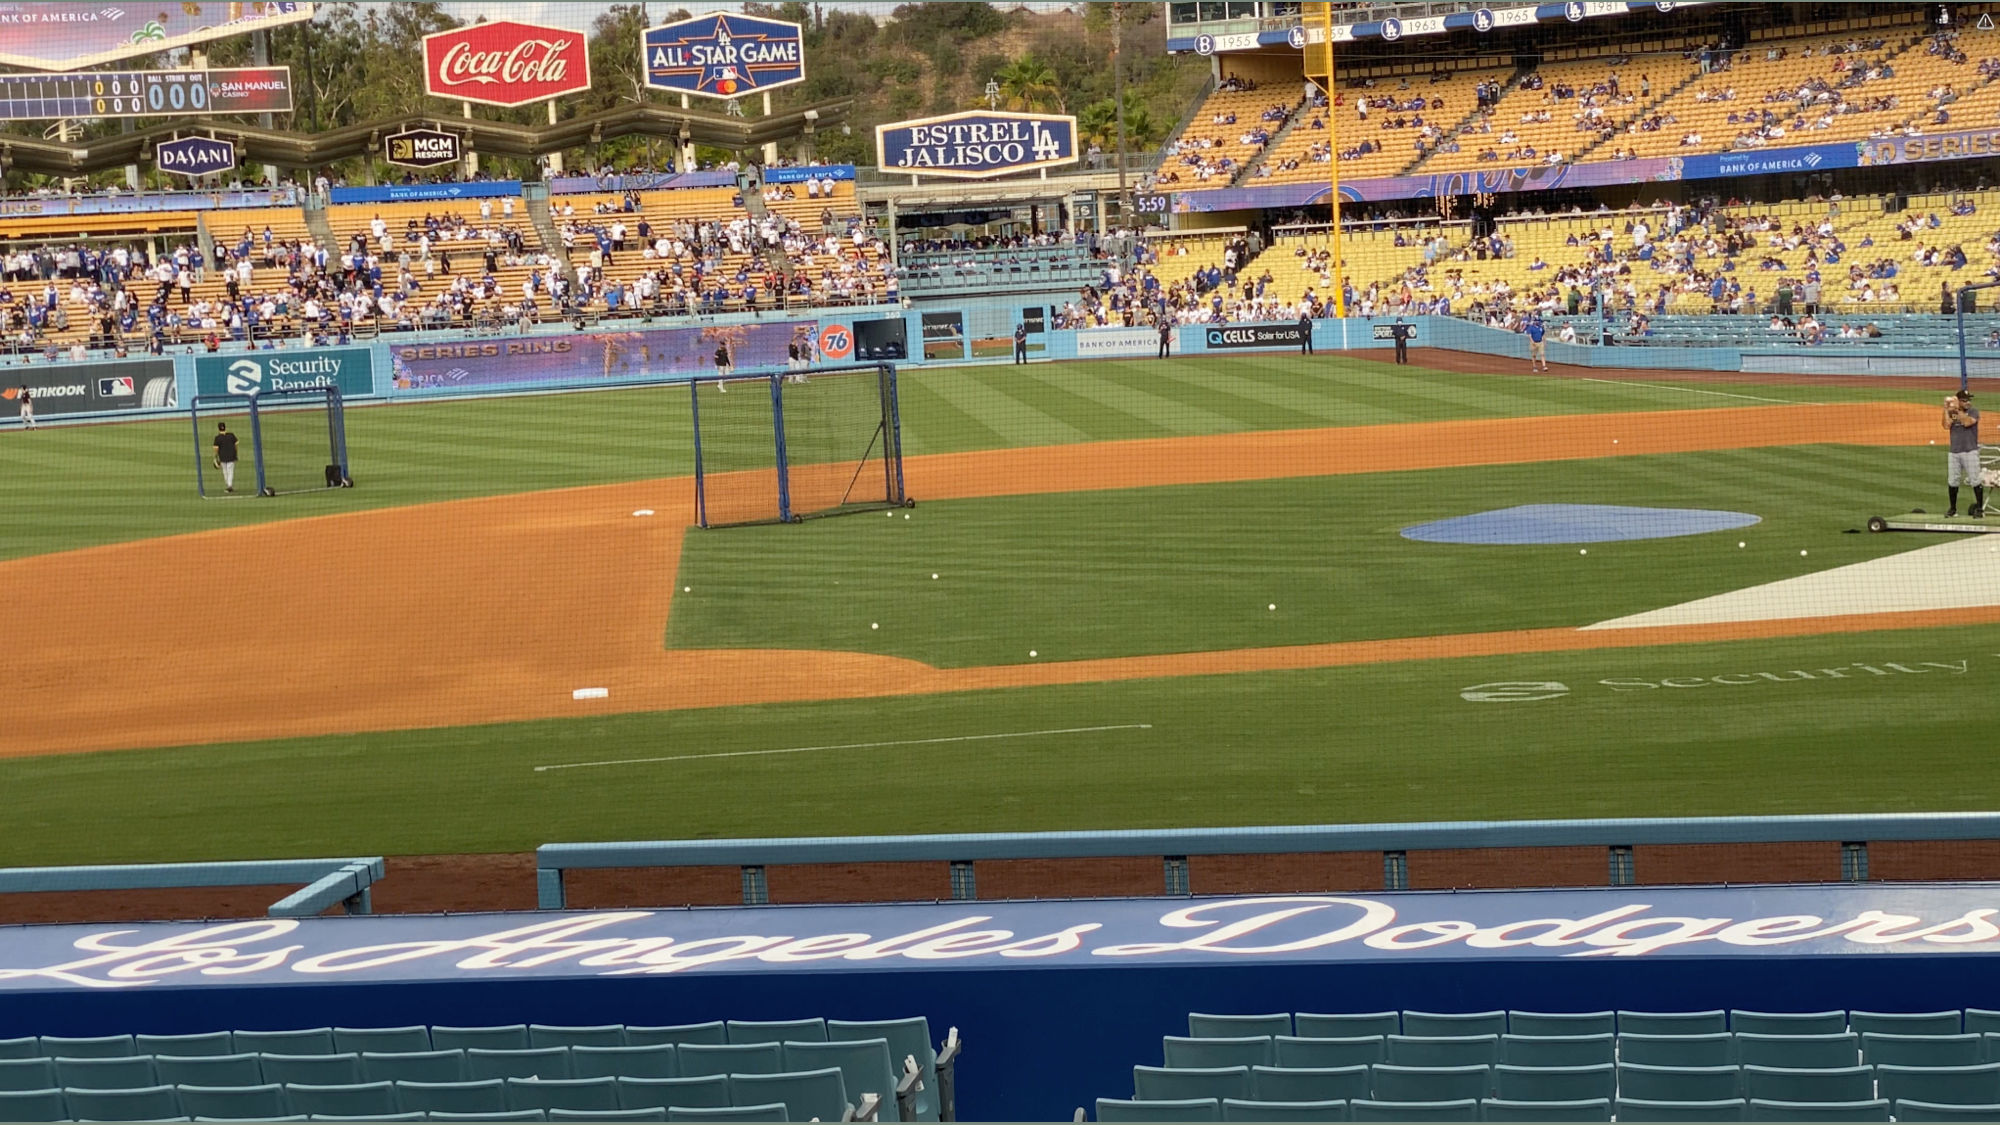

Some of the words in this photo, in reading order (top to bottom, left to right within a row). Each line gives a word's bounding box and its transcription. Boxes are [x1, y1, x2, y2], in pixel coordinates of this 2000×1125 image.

[22, 14, 37, 22] OF
[41, 13, 98, 22] AMERICA
[1501, 10, 1529, 23] 1965
[1409, 21, 1436, 33] 1963
[717, 28, 731, 46] LA
[1222, 36, 1251, 48] 1955
[1200, 38, 1211, 53] B
[439, 38, 572, 86] Coca-Cola
[653, 47, 688, 68] ALL
[691, 45, 738, 65] STAR
[740, 42, 797, 63] GAME
[148, 75, 162, 83] BALL
[165, 74, 186, 82] STRIKE
[190, 74, 203, 82] OUT
[221, 83, 243, 91] SAN
[244, 81, 287, 90] MANUEL
[95, 81, 104, 95] 0
[112, 80, 121, 94] 0
[130, 80, 139, 94] 0
[149, 84, 164, 110] 0
[169, 83, 185, 109] 0
[190, 83, 205, 109] 0
[97, 99, 106, 113] 0
[114, 98, 122, 112] 0
[132, 98, 140, 112] 0
[909, 121, 1029, 147] ESTREL
[414, 138, 453, 151] MGM
[163, 146, 228, 167] DASANI
[415, 150, 454, 159] RESORTS
[898, 143, 1025, 168] JALISCO
[1720, 165, 1745, 174] BANK
[1748, 163, 1760, 171] OF
[1762, 160, 1803, 170] AMERICA
[1138, 197, 1166, 212] 5:59
[825, 331, 849, 352] 76
[1257, 332, 1275, 340] Solar
[1275, 332, 1285, 340] for
[1285, 330, 1300, 339] USA
[400, 343, 499, 361] SERIES
[507, 340, 572, 356] RING
[1119, 339, 1158, 347] AMERICA
[268, 356, 342, 376] Security
[1598, 659, 1967, 692] Security
[0, 919, 304, 987] Los
[291, 911, 1103, 975] Angeles
[1091, 896, 2000, 957] Dodgers
